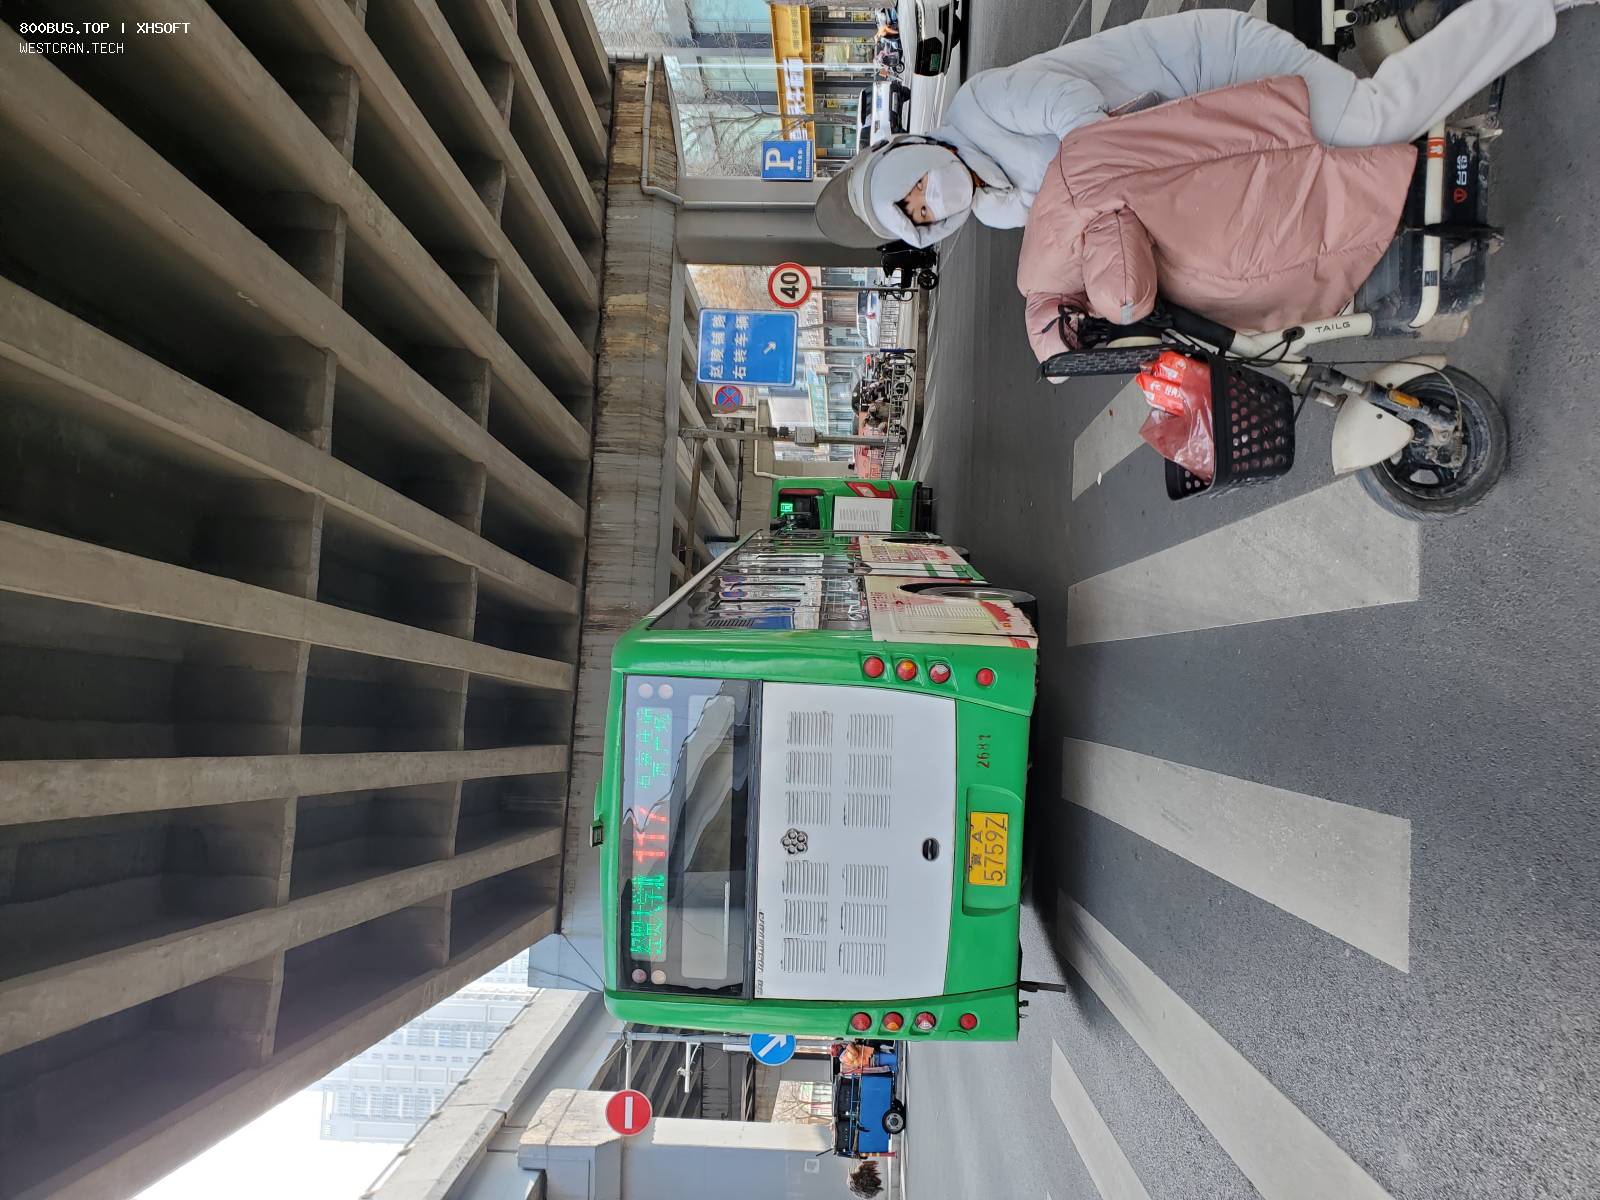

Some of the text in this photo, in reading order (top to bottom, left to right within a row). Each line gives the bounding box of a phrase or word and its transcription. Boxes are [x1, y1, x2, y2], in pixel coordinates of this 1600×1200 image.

[764, 147, 794, 171] P
[780, 272, 800, 299] 40
[1314, 321, 1351, 333] TAILG
[732, 315, 749, 380] 右转车辆
[983, 816, 1005, 882] 5759Z
